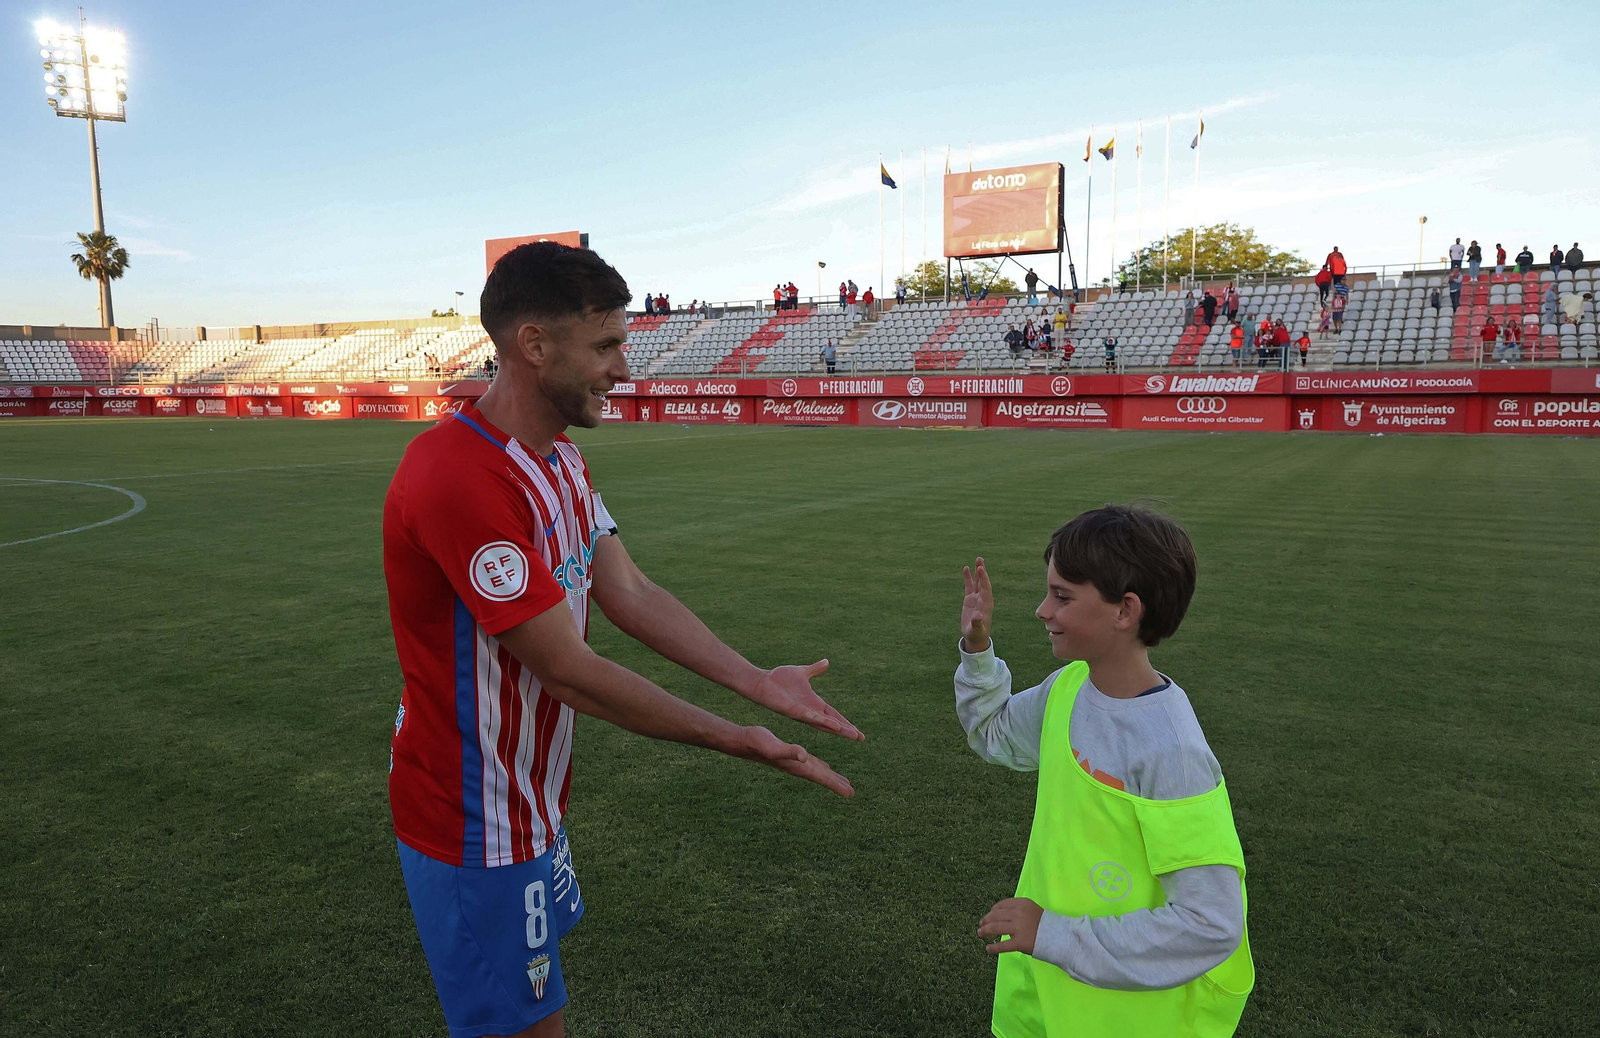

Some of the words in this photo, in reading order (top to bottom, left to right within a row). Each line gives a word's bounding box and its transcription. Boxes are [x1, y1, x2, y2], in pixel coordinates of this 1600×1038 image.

[829, 378, 884, 394] FEDERACIÓN
[961, 377, 1023, 394] FEDERACIÓN
[1169, 375, 1259, 392] Lavahostel
[1416, 377, 1473, 387] PODOLOGÍA
[98, 387, 140, 395] GEFCO
[143, 387, 173, 395] GEFCO
[649, 381, 689, 395] Adecco
[694, 381, 737, 395] Adecco
[57, 400, 89, 408] caser
[110, 400, 138, 408] caser
[160, 399, 181, 407] caser
[357, 404, 377, 413] BODY
[378, 404, 410, 413] FACTORY
[664, 403, 698, 414] ELEAL
[700, 403, 720, 414] S.L.
[721, 399, 741, 416] 40
[763, 399, 792, 417] Pepe
[793, 399, 845, 415] Valencia
[908, 402, 967, 412] HYUNDAI
[1534, 398, 1600, 416] popula
[996, 401, 1088, 419] Algetransit
[1370, 404, 1455, 415] Ayuntamiento
[1187, 416, 1215, 424] Campo
[1376, 416, 1389, 425] de
[1391, 415, 1447, 427] Algeciras
[1494, 419, 1520, 427] CON
[1521, 419, 1535, 427] EL
[1537, 419, 1591, 427] DEPORTE
[524, 879, 548, 949] 8
